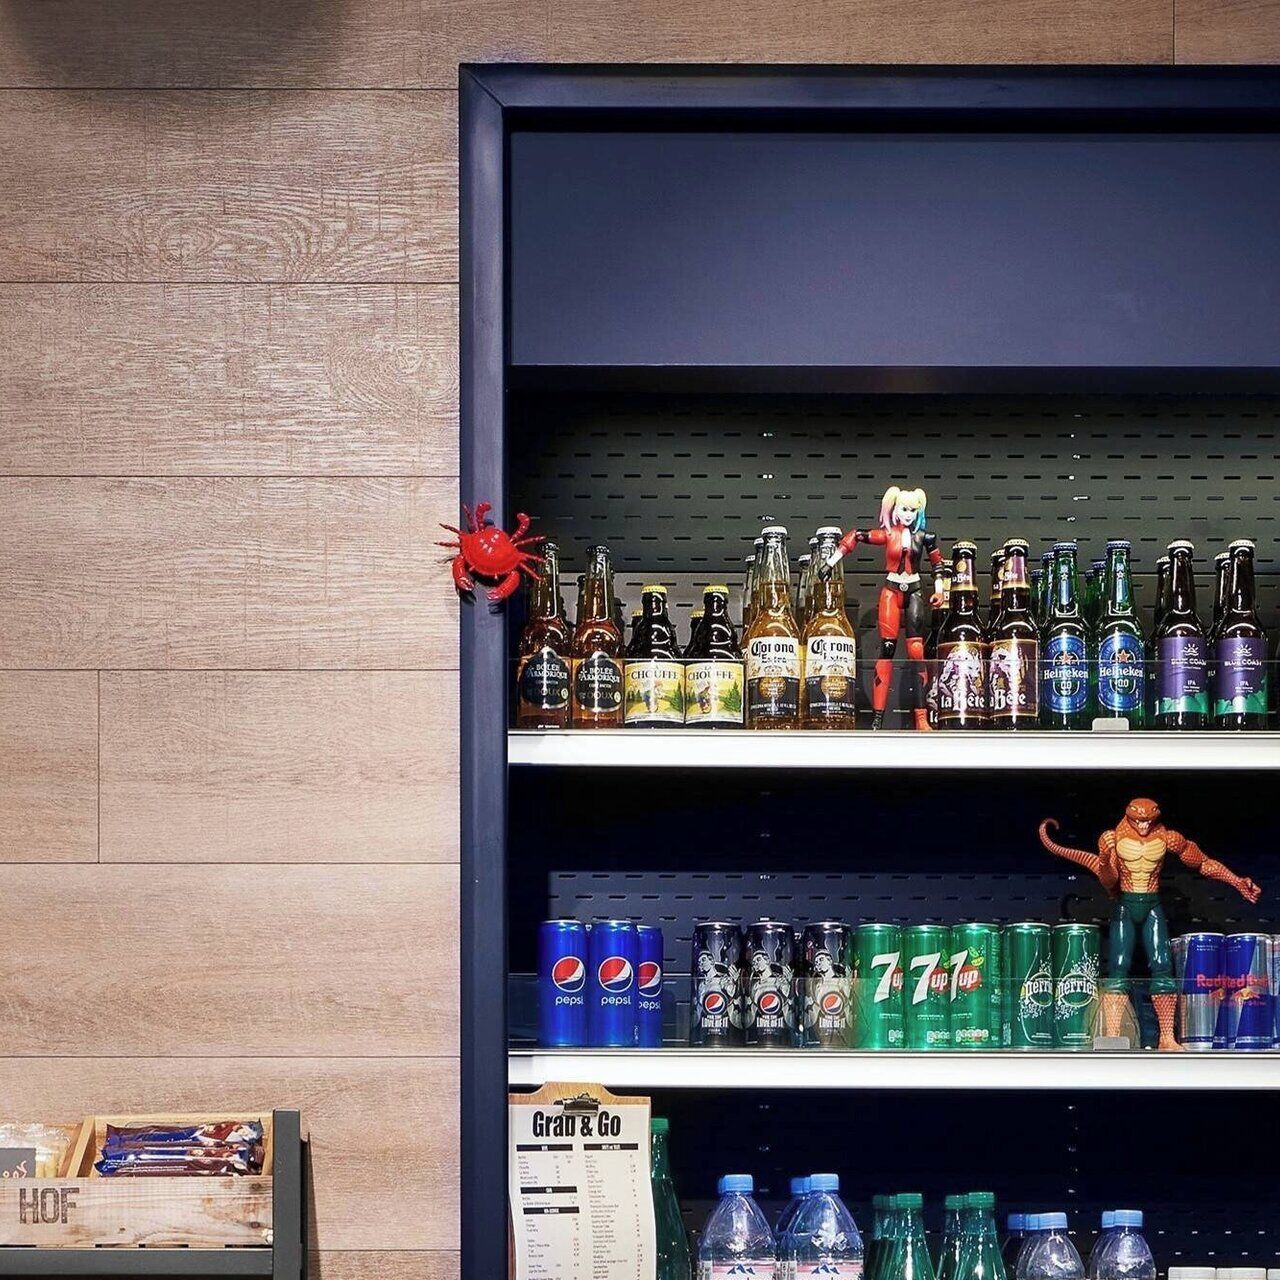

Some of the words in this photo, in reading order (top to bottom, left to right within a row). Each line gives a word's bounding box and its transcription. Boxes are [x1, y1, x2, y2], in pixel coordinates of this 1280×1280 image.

[751, 639, 795, 658] Corona
[811, 638, 854, 657] Corona
[1043, 667, 1088, 680] Heineken
[1099, 665, 1144, 677] Heineken
[1058, 978, 1097, 995] perrier
[555, 995, 584, 1006] pepsi
[601, 995, 631, 1006] pepsi
[598, 1110, 622, 1138] Go
[19, 1187, 80, 1224] HOF
